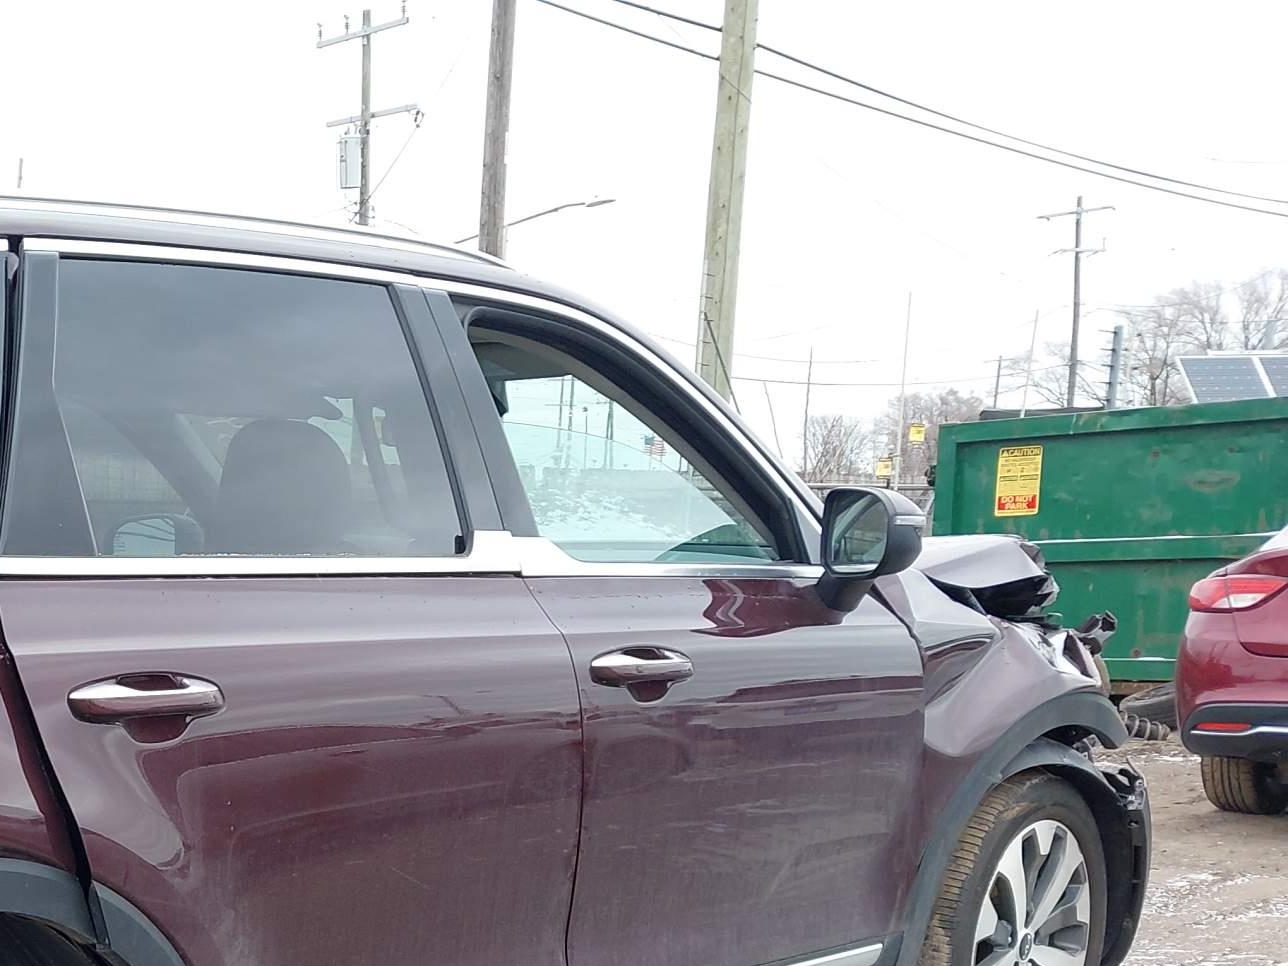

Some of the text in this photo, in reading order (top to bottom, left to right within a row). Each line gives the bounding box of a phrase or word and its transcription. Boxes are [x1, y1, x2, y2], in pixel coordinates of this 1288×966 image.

[1009, 448, 1040, 457] CAUTION
[1001, 494, 1033, 503] DO NOT
[1005, 502, 1029, 510] PARK
